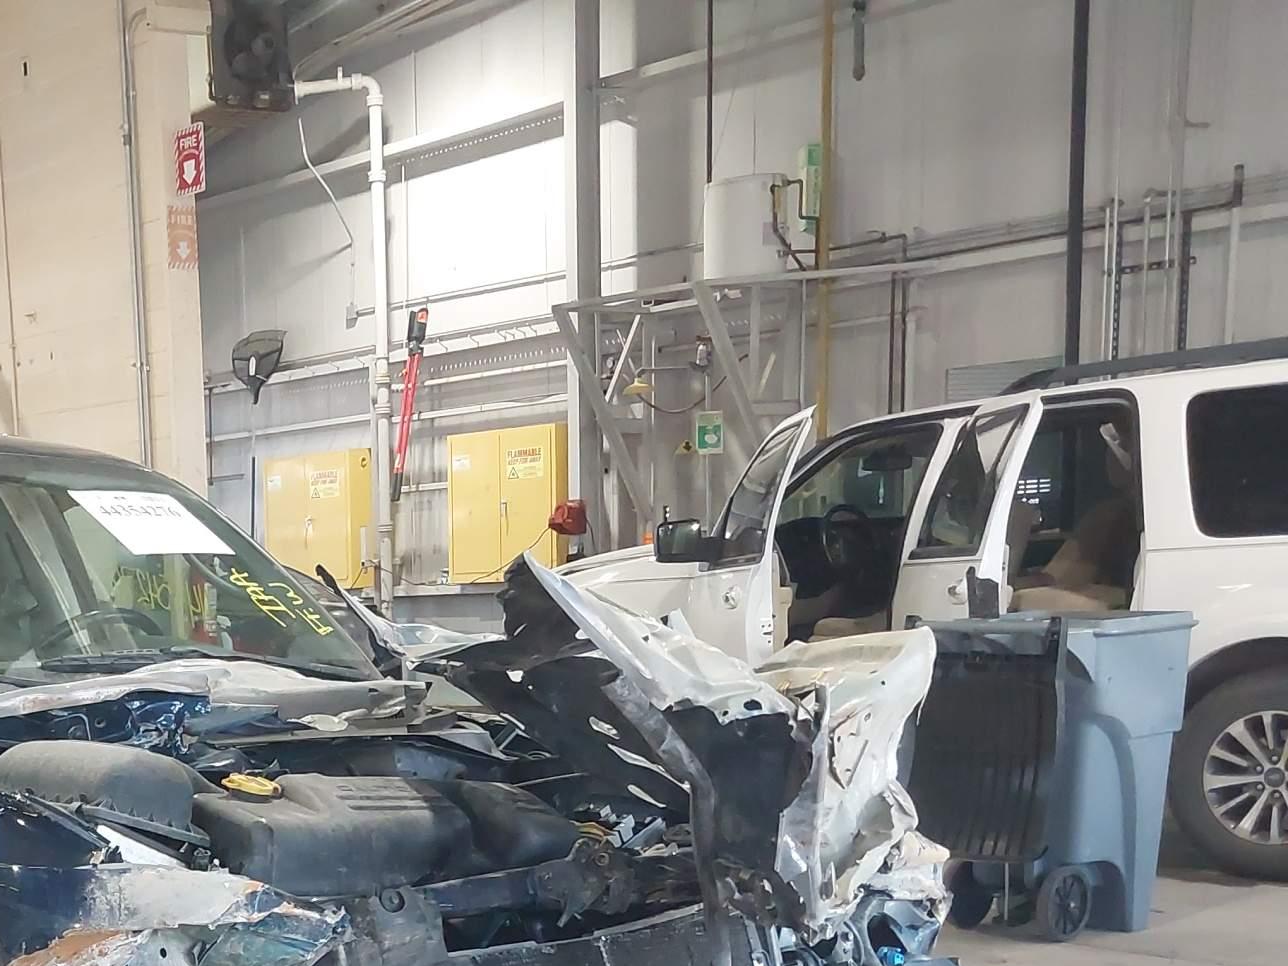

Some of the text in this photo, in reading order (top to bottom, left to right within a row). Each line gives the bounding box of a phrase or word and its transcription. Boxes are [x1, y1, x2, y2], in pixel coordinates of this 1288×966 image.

[179, 135, 197, 151] FIRE
[171, 214, 193, 225] FIRE
[508, 448, 541, 458] FLAMMABLE
[100, 504, 182, 518] 44354276
